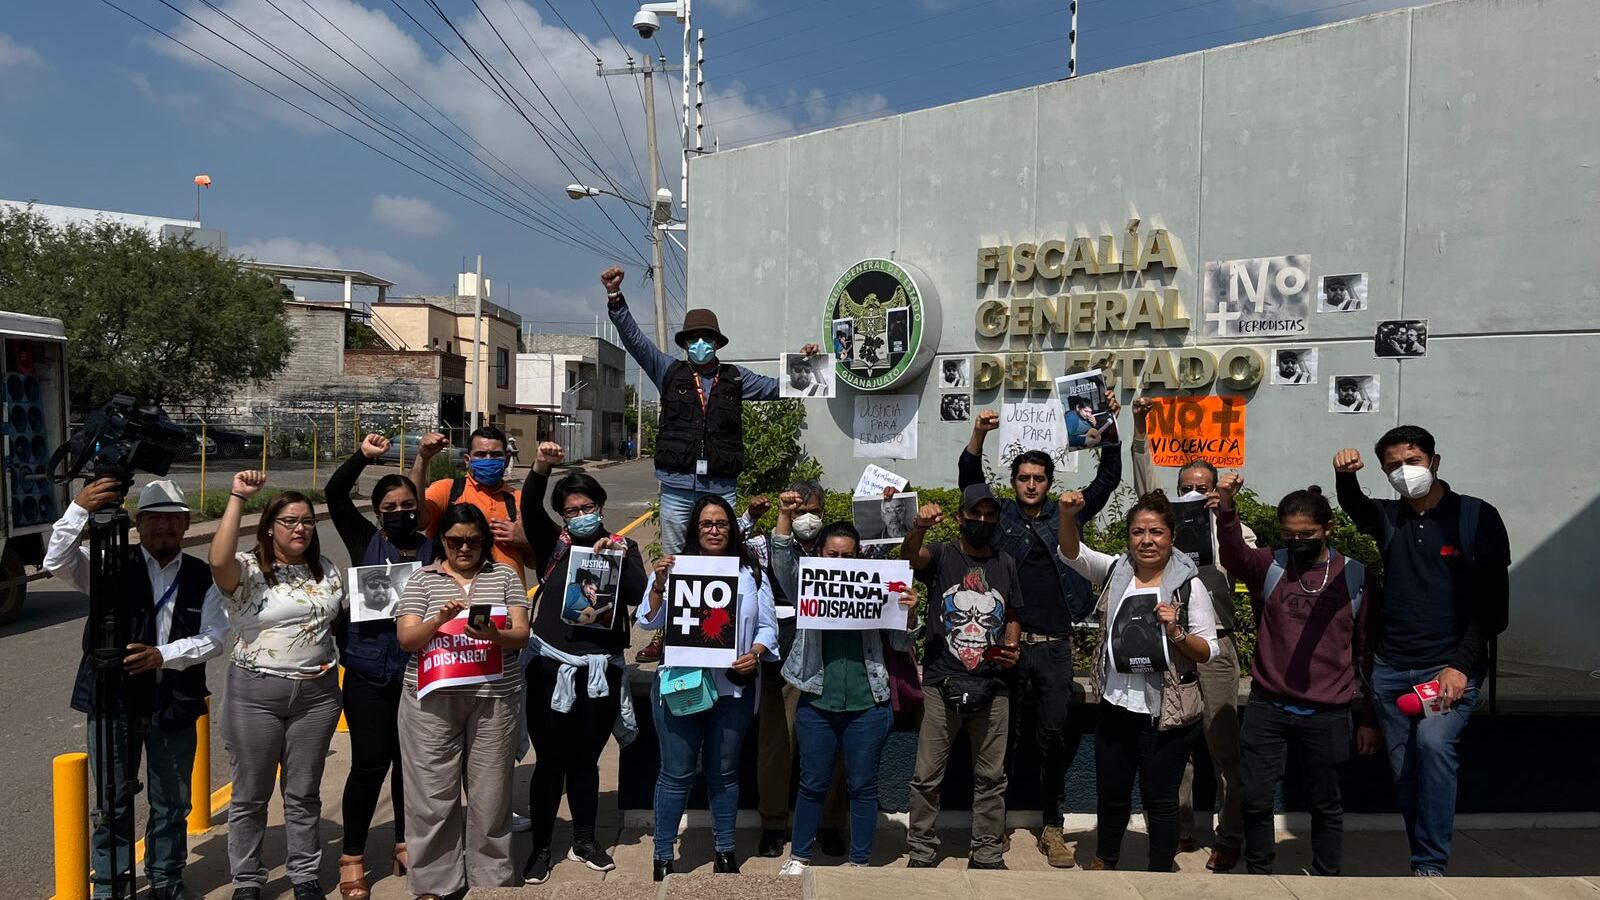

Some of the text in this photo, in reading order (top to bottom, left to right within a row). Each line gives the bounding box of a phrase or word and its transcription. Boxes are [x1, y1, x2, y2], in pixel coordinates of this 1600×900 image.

[977, 219, 1178, 284] FISCALÍA
[845, 262, 886, 280] GENERAL
[887, 263, 904, 279] DEL
[903, 278, 921, 322] ESTADO
[975, 289, 1190, 338] GENERAL
[1238, 319, 1305, 333] PERIODISTAS
[841, 368, 900, 388] GUANAJUATO
[973, 347, 1265, 391] DEL ESTADO
[1070, 382, 1097, 395] JUSTICIA
[870, 419, 897, 431] PARA
[1022, 425, 1054, 442] PARA
[1151, 438, 1240, 455] VIOLENCIA
[581, 559, 610, 569] JUSTICIA
[674, 579, 732, 609] NO
[801, 567, 889, 606] PRENSA,
[1129, 656, 1152, 665] JUSTICIA
